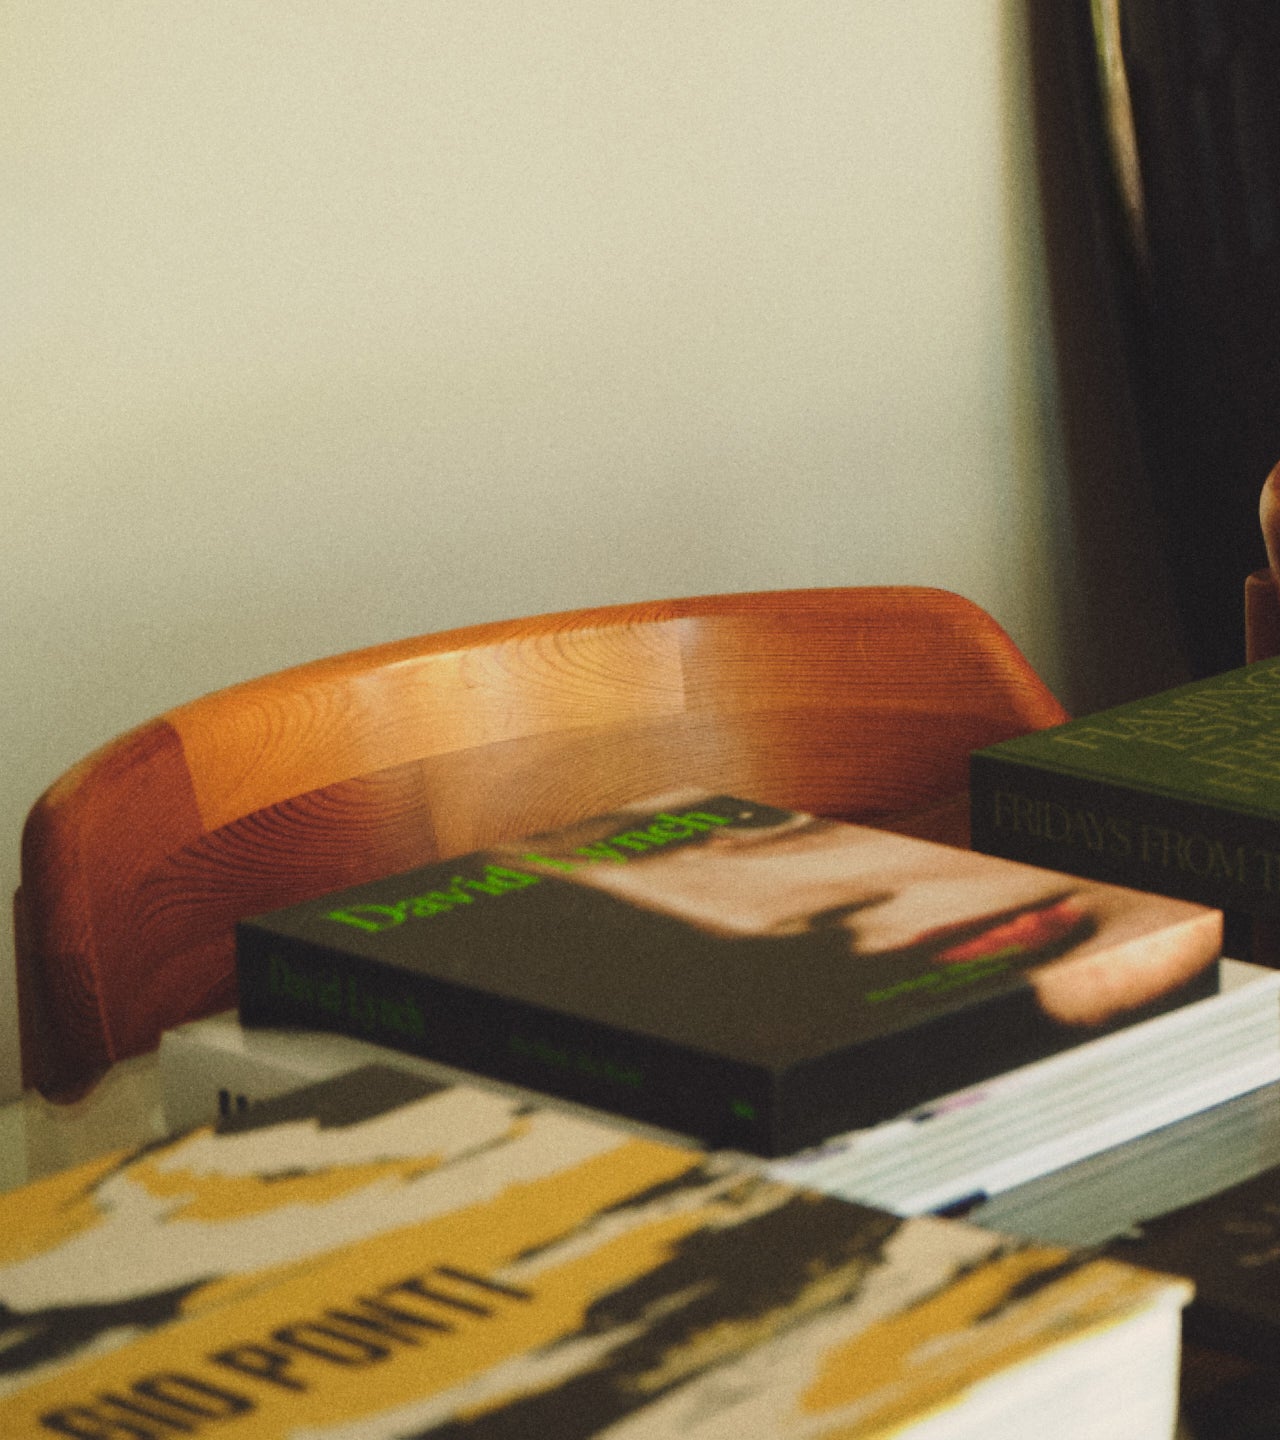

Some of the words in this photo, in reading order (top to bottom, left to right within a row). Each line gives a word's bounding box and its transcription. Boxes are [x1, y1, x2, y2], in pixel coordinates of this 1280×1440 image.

[326, 864, 541, 933] David
[522, 810, 731, 872] Lynch
[205, 1265, 534, 1394] PONTI
